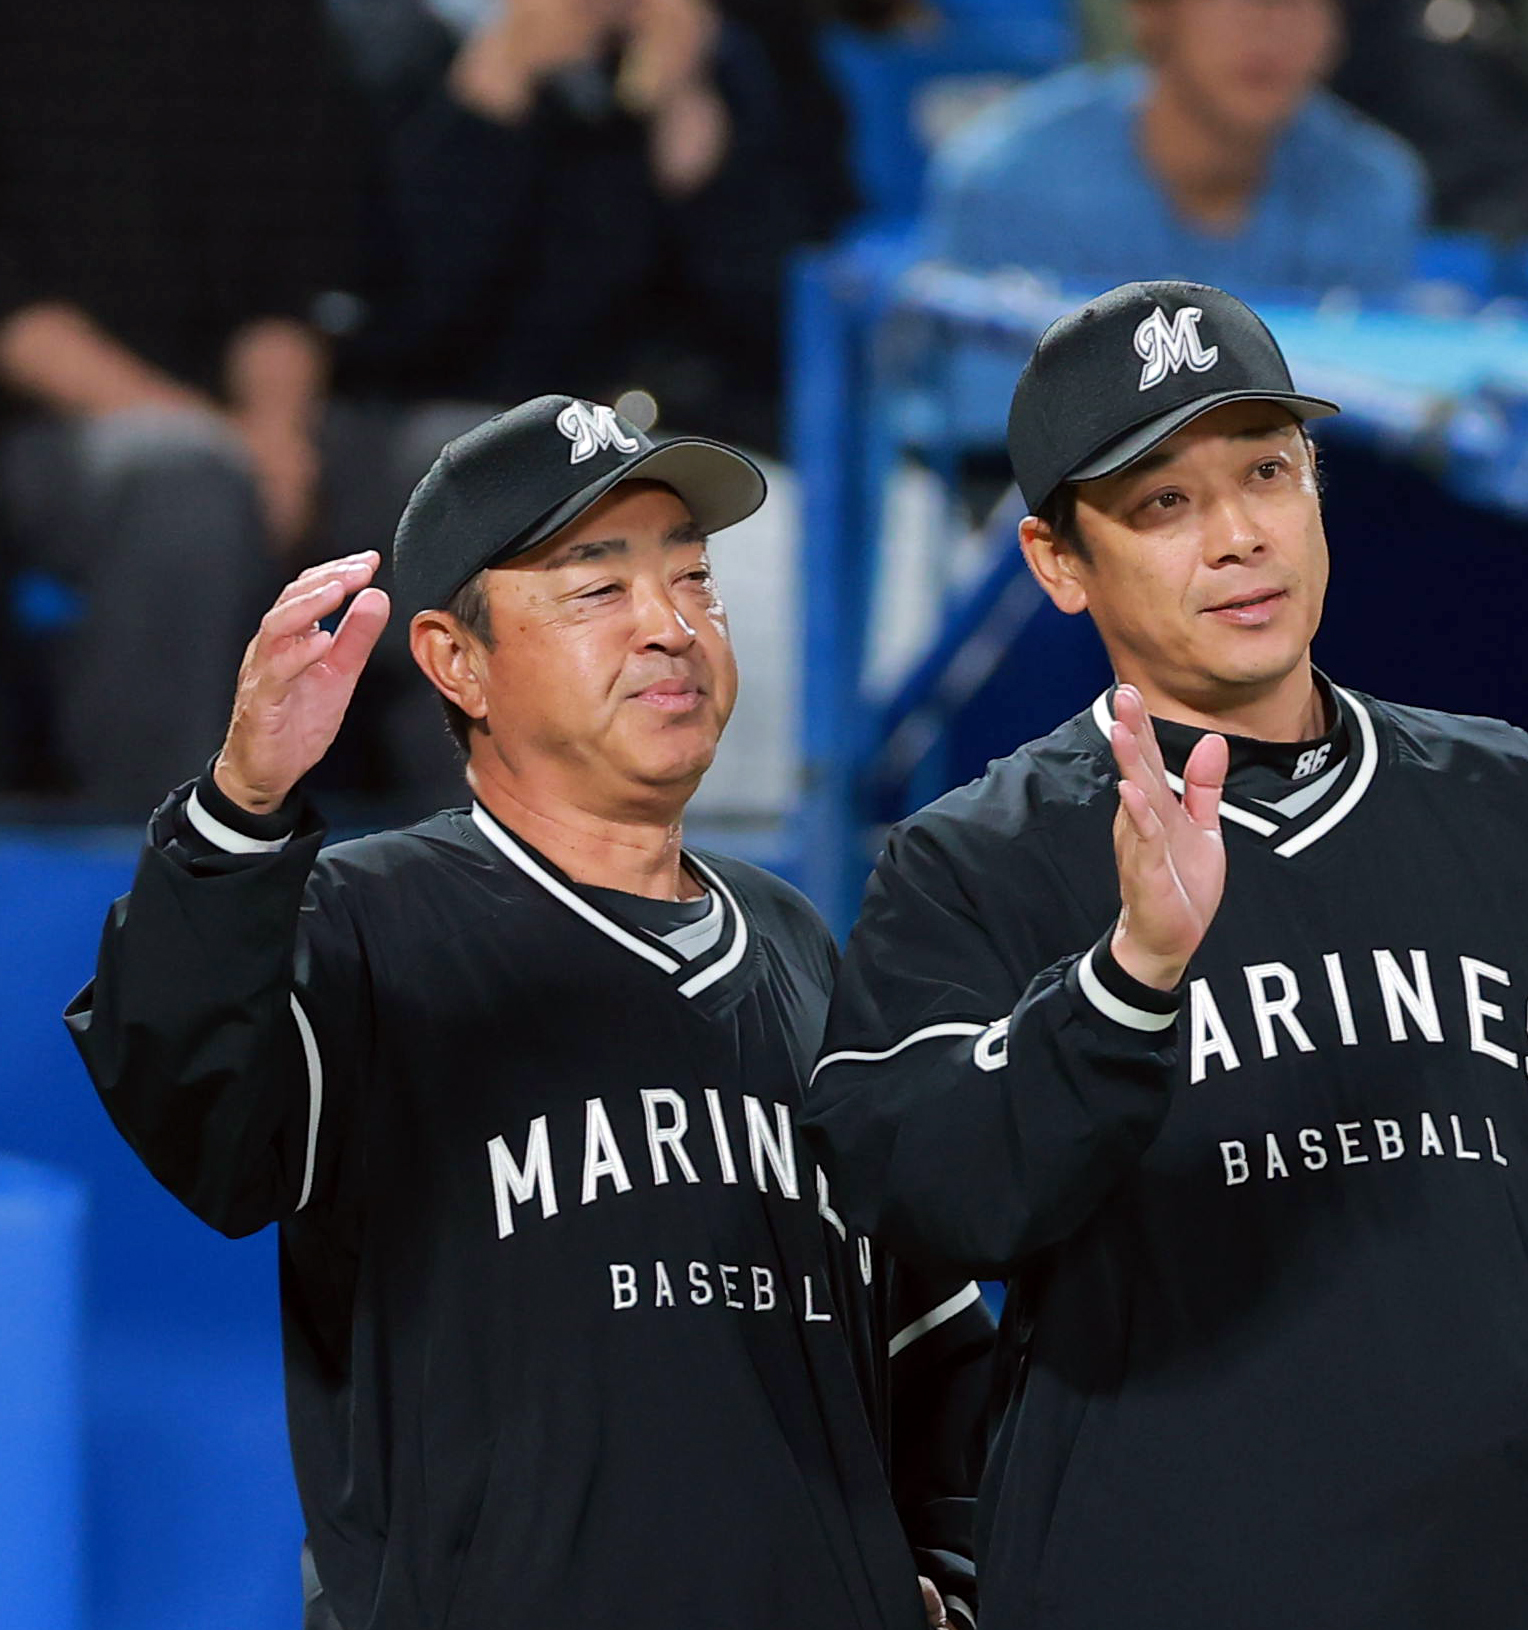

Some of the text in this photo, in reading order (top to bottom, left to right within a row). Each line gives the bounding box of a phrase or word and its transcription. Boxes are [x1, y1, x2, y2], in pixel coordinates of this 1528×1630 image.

[1133, 306, 1218, 391] M
[556, 401, 639, 464] M
[1291, 743, 1331, 780] 86
[1220, 1112, 1508, 1186] BASEBALL
